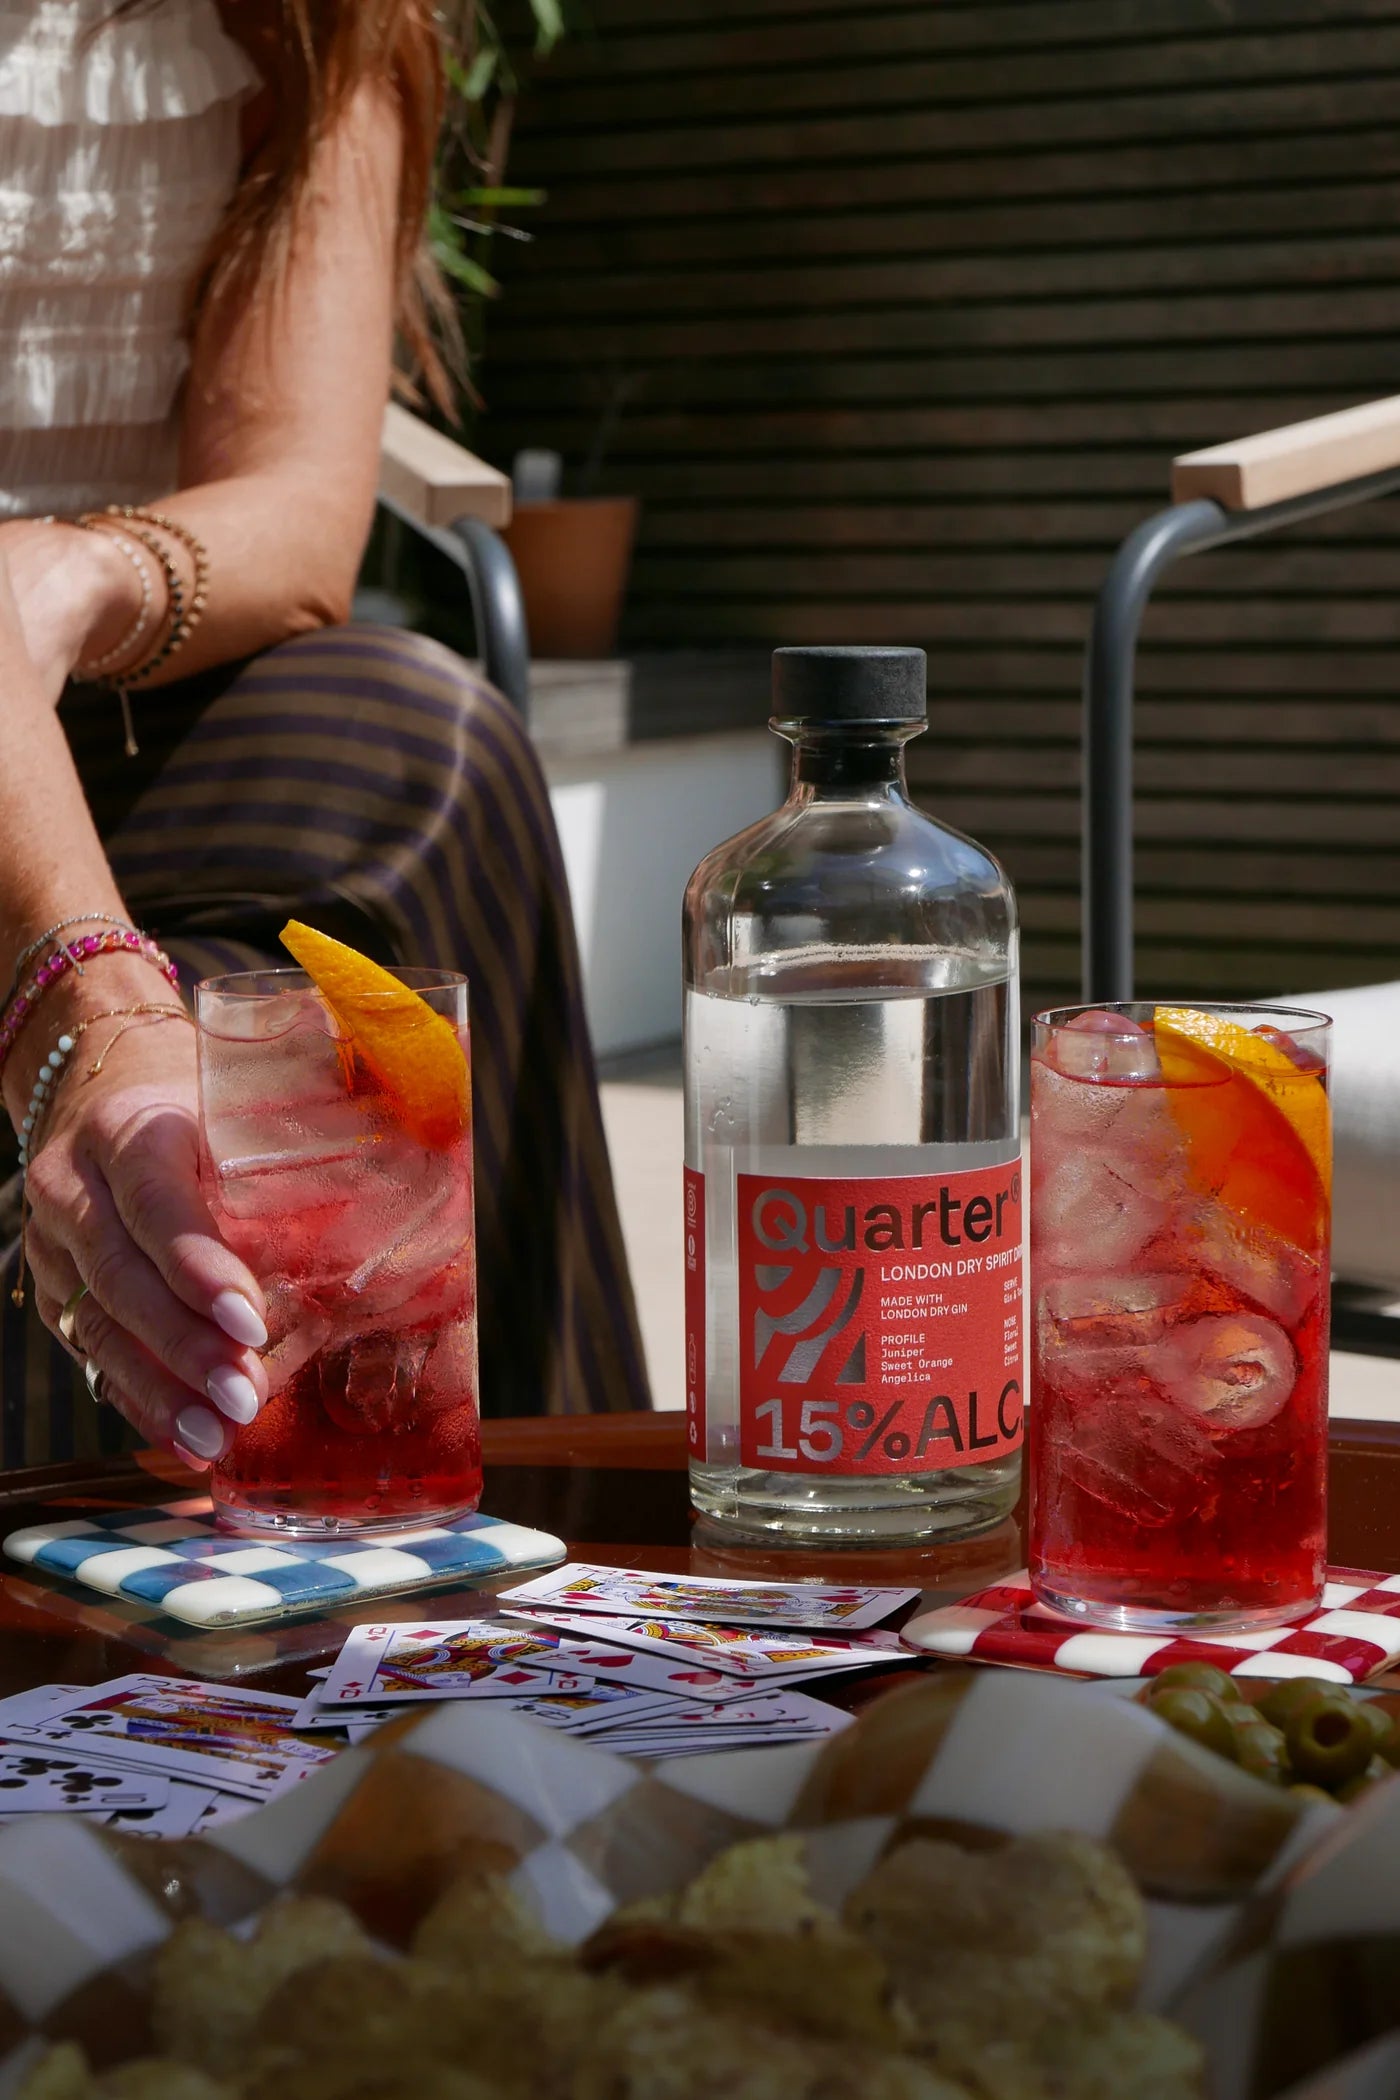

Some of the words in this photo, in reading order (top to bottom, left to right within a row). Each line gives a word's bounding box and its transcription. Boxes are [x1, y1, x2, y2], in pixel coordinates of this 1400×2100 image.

[881, 1262, 952, 1281] LONDON
[957, 1257, 983, 1276] DRY
[985, 1248, 1013, 1271] SPIRIT
[1003, 1276, 1018, 1291] SERVE
[881, 1296, 913, 1307] MADE
[915, 1293, 943, 1305] WITH
[881, 1308, 928, 1320] LONDON
[930, 1305, 949, 1317] DRY
[951, 1303, 968, 1314] GIN
[881, 1333, 926, 1345] PROFILE
[1003, 1326, 1019, 1341] Floral
[881, 1347, 925, 1359] Juniper
[881, 1361, 913, 1372] Sweet
[918, 1358, 953, 1369] Orange
[881, 1372, 931, 1385] Angelica
[367, 1626, 388, 1636] Q
[558, 1679, 578, 1689] Q
[339, 1688, 362, 1699] Q
[7, 1723, 42, 1736] J
